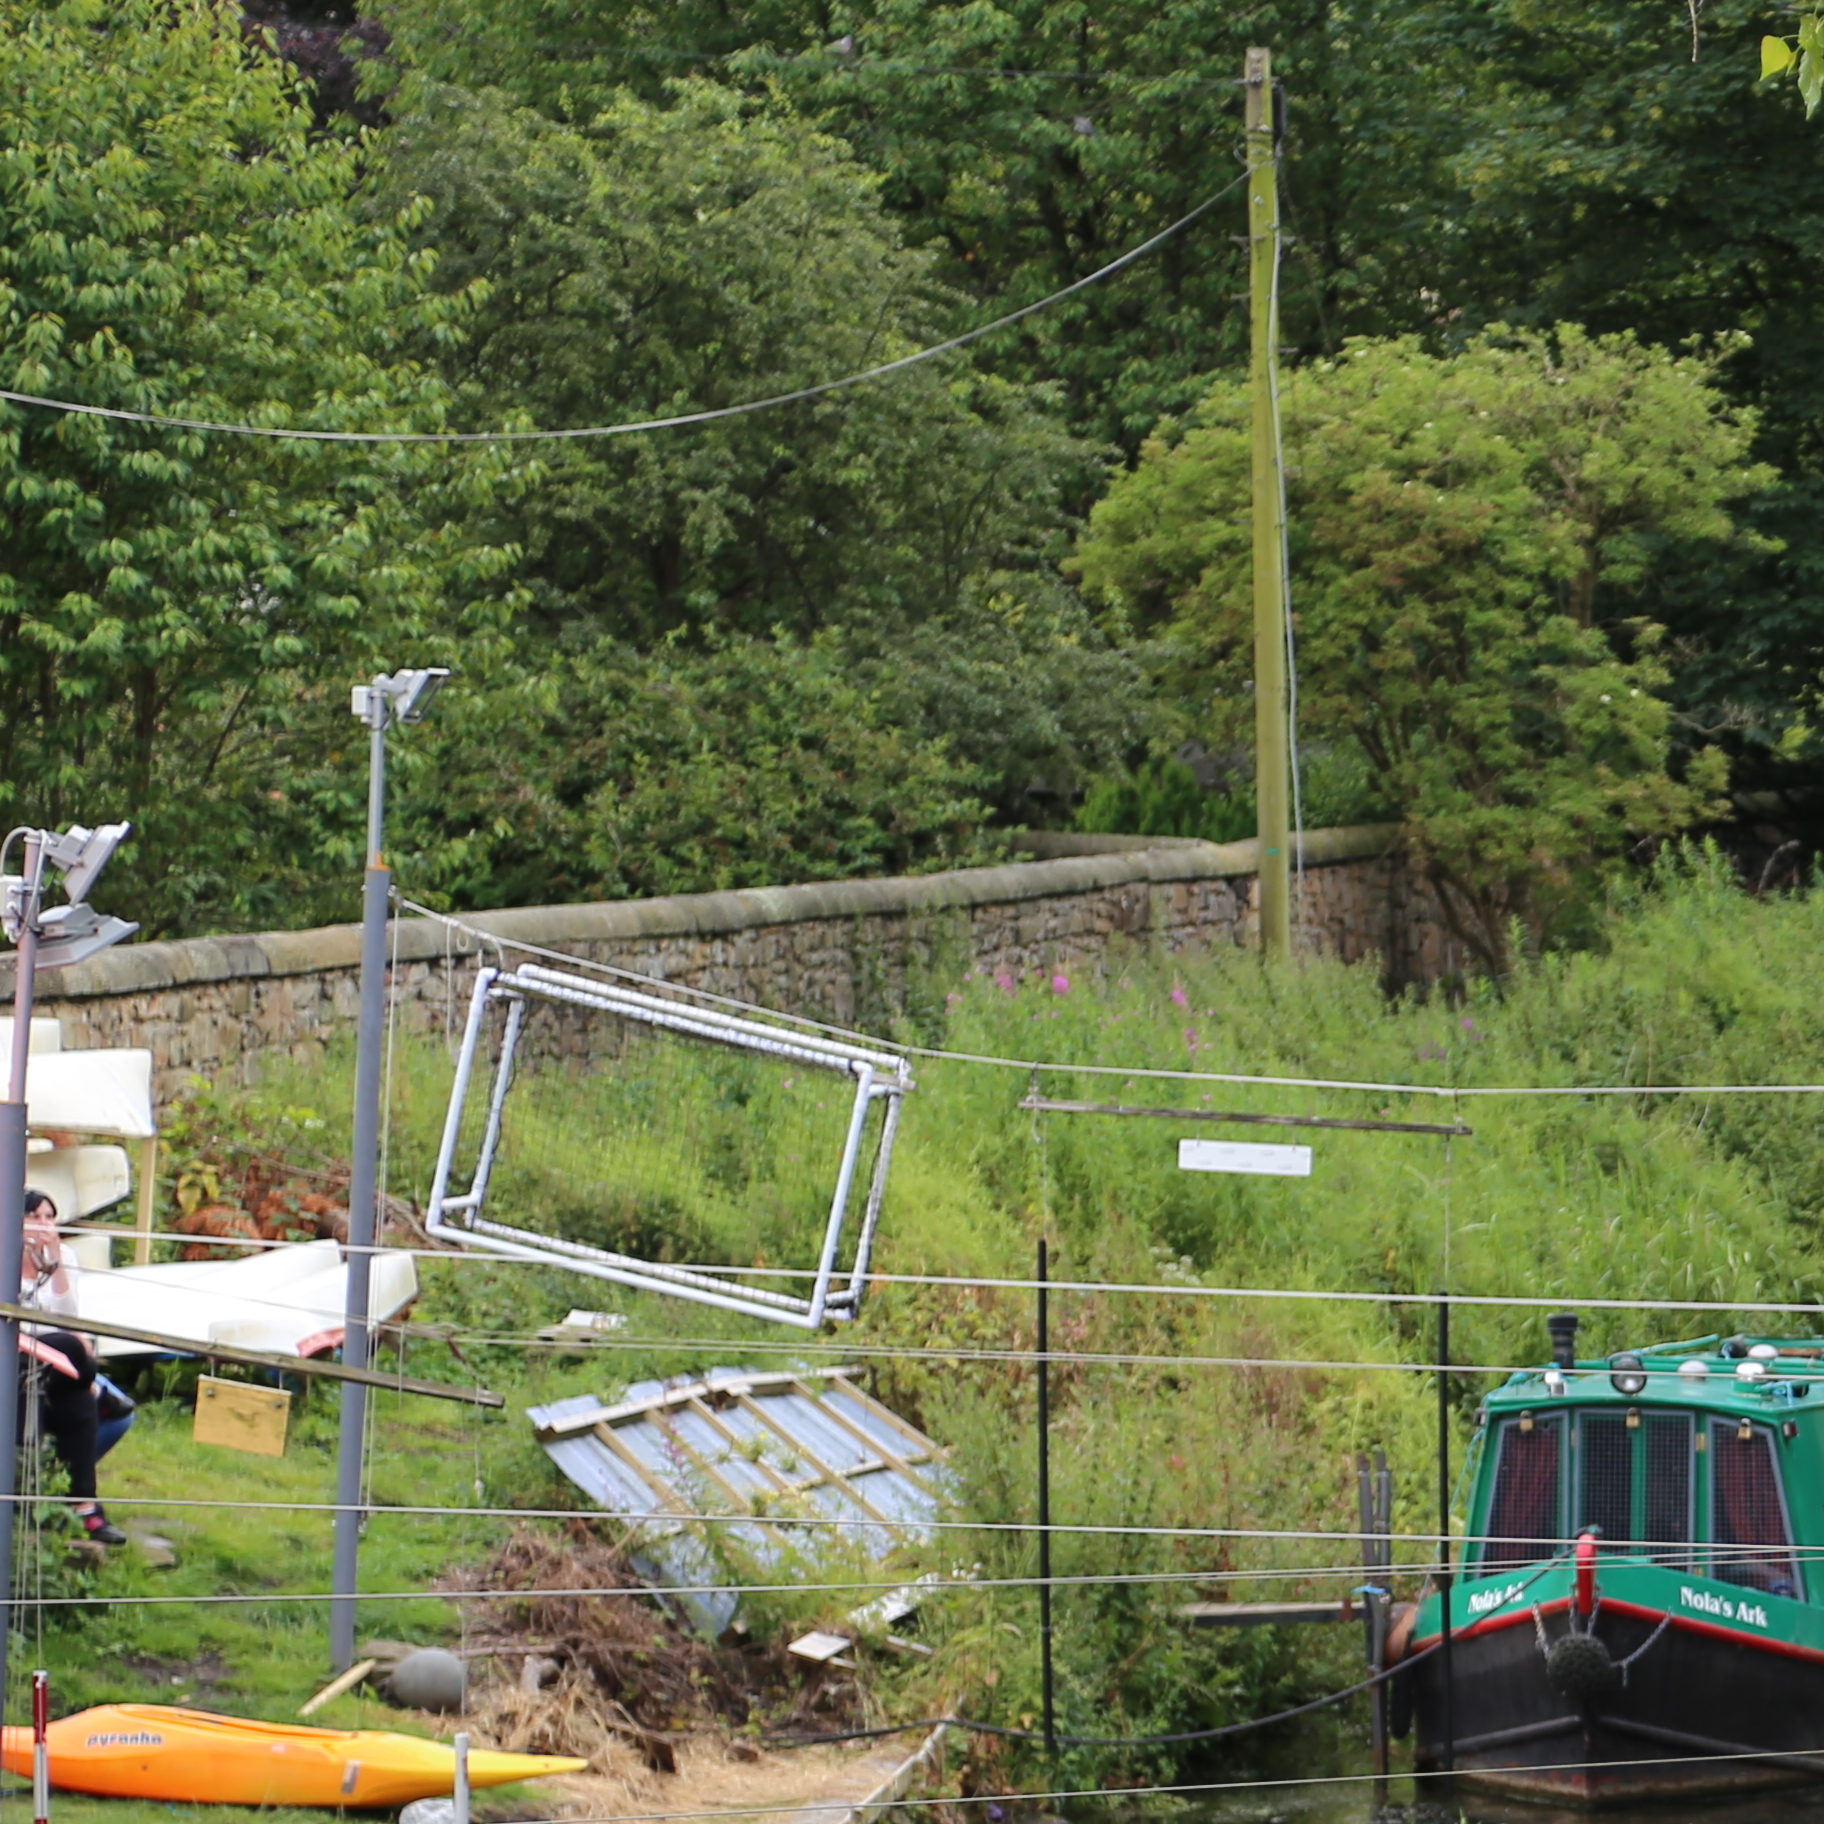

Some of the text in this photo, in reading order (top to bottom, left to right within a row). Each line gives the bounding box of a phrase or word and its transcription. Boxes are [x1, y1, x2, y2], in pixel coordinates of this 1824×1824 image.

[1467, 1586, 1504, 1614] Nola's
[1680, 1585, 1769, 1629] Nola's Ark
[87, 1730, 162, 1747] pyranha
